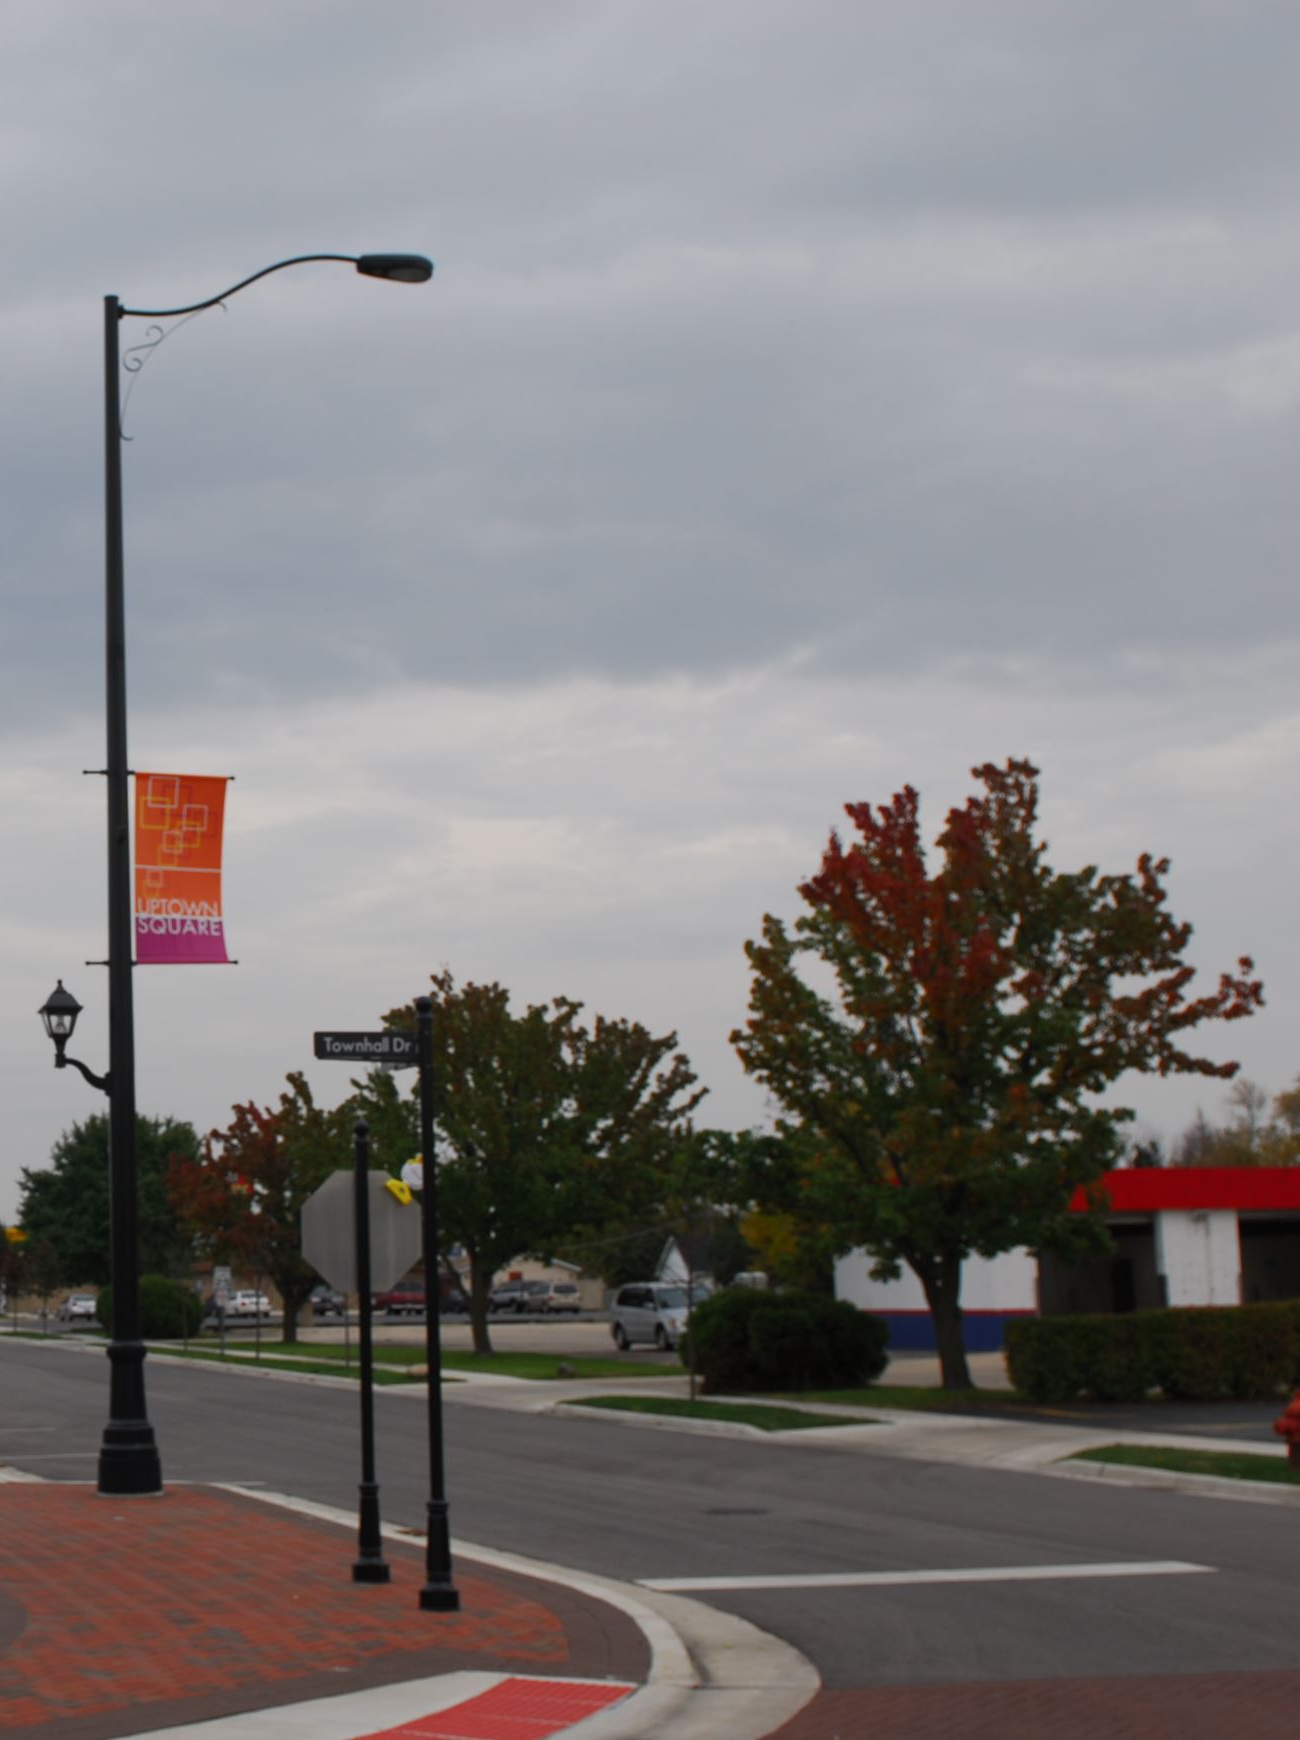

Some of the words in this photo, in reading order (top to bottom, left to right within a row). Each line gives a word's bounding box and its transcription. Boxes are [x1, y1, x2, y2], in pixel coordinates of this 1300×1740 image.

[137, 897, 219, 917] UPTOWN
[138, 916, 220, 936] SQUARE
[323, 1036, 389, 1053] Townhall
[393, 1036, 412, 1053] Dr
